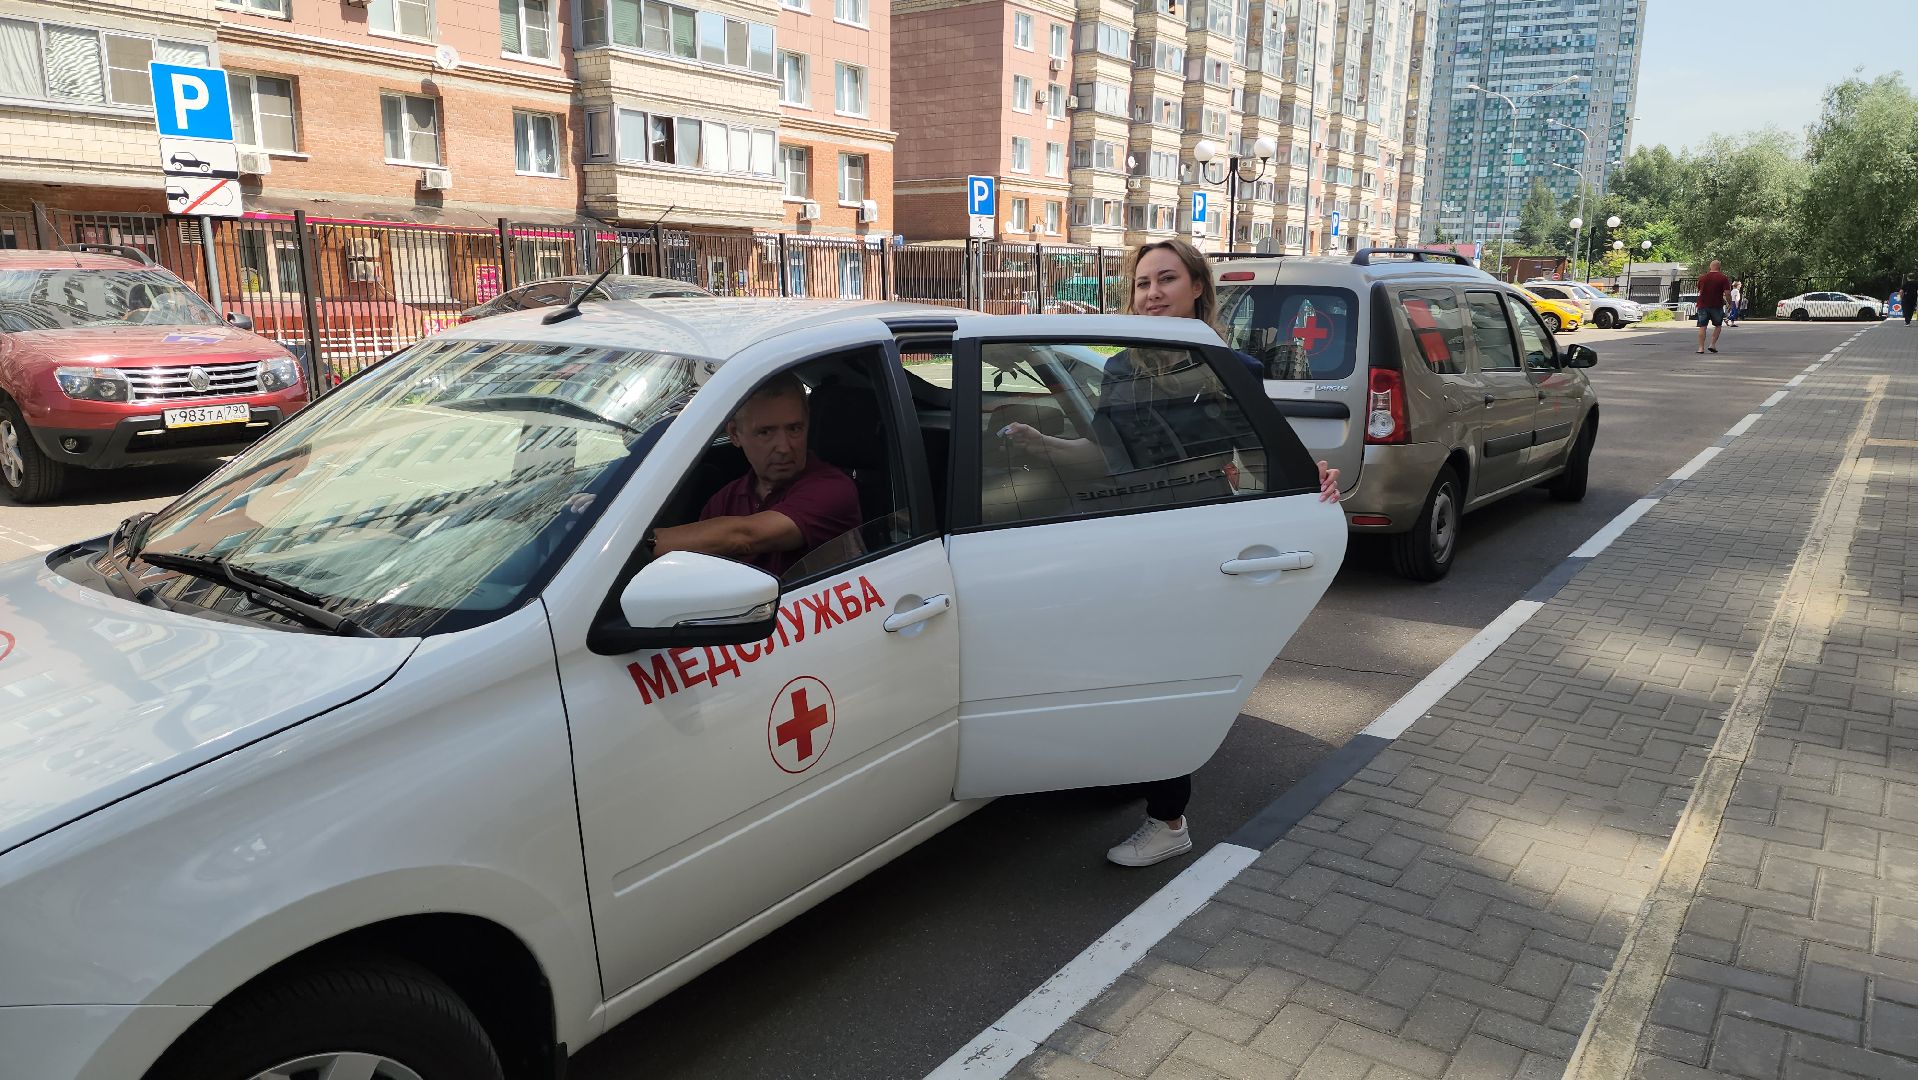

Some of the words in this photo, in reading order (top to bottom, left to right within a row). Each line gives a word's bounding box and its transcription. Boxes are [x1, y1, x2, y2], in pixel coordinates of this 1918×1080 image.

[170, 73, 209, 130] P
[973, 180, 989, 212] P
[1195, 194, 1205, 220] P
[225, 404, 246, 416] 790
